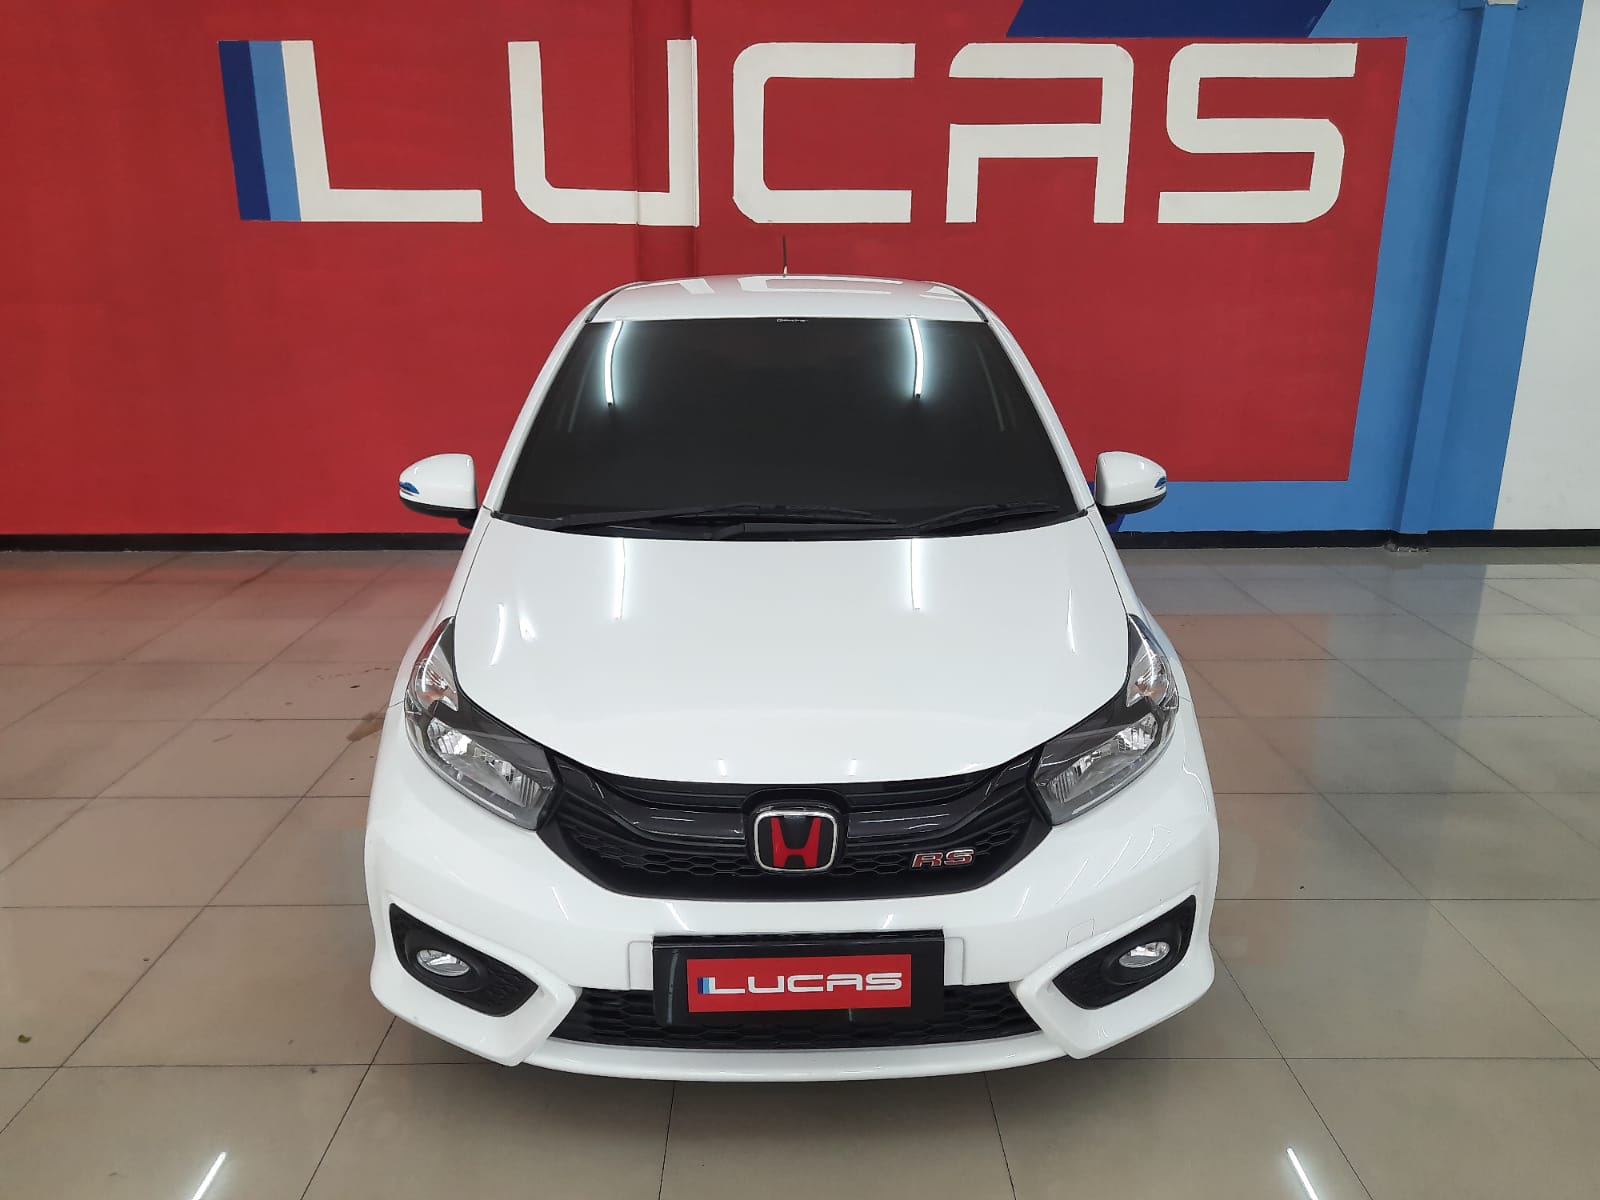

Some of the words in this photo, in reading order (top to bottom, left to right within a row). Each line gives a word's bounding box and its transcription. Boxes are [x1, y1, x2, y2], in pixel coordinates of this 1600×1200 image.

[281, 37, 1357, 226] LUCAS
[911, 849, 975, 868] RS
[708, 972, 902, 995] LUCAS
